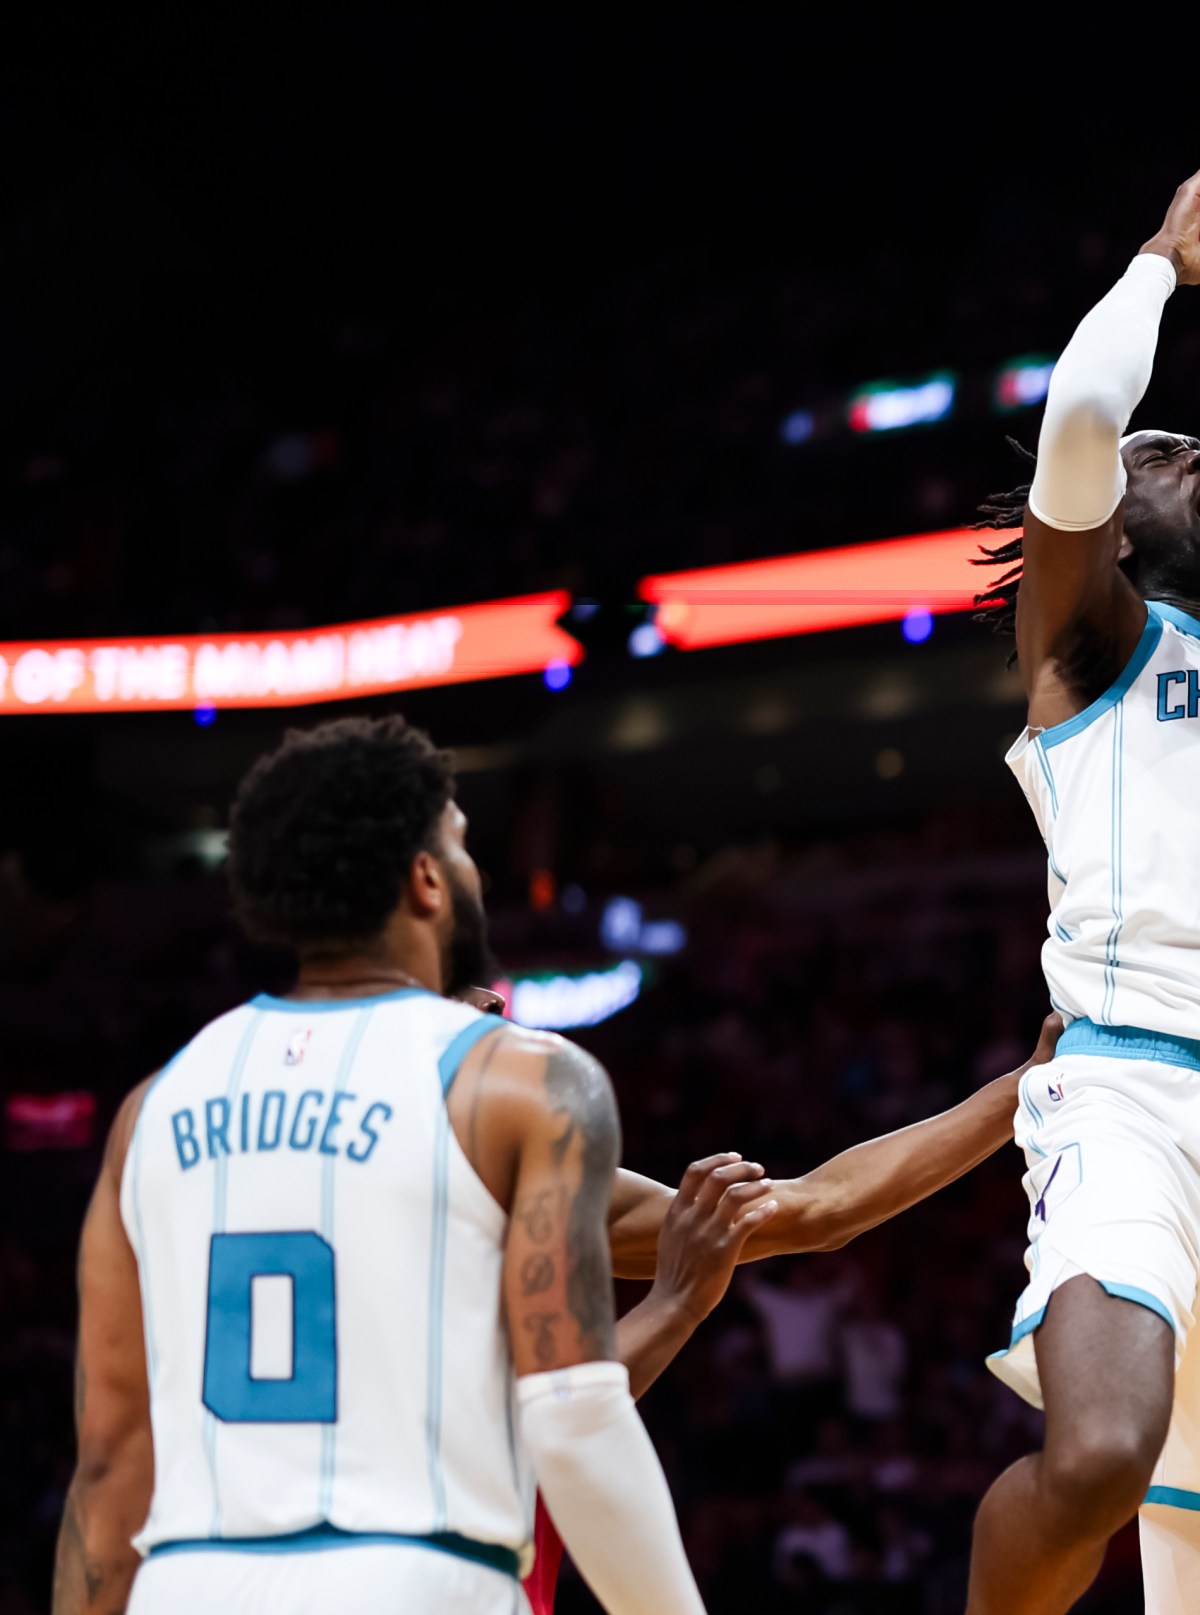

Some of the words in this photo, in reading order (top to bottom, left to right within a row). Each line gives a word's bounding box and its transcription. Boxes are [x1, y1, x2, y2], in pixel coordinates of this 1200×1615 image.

[13, 650, 84, 703] OF
[170, 1089, 394, 1173] BRIDGES
[201, 1231, 339, 1424] 0
